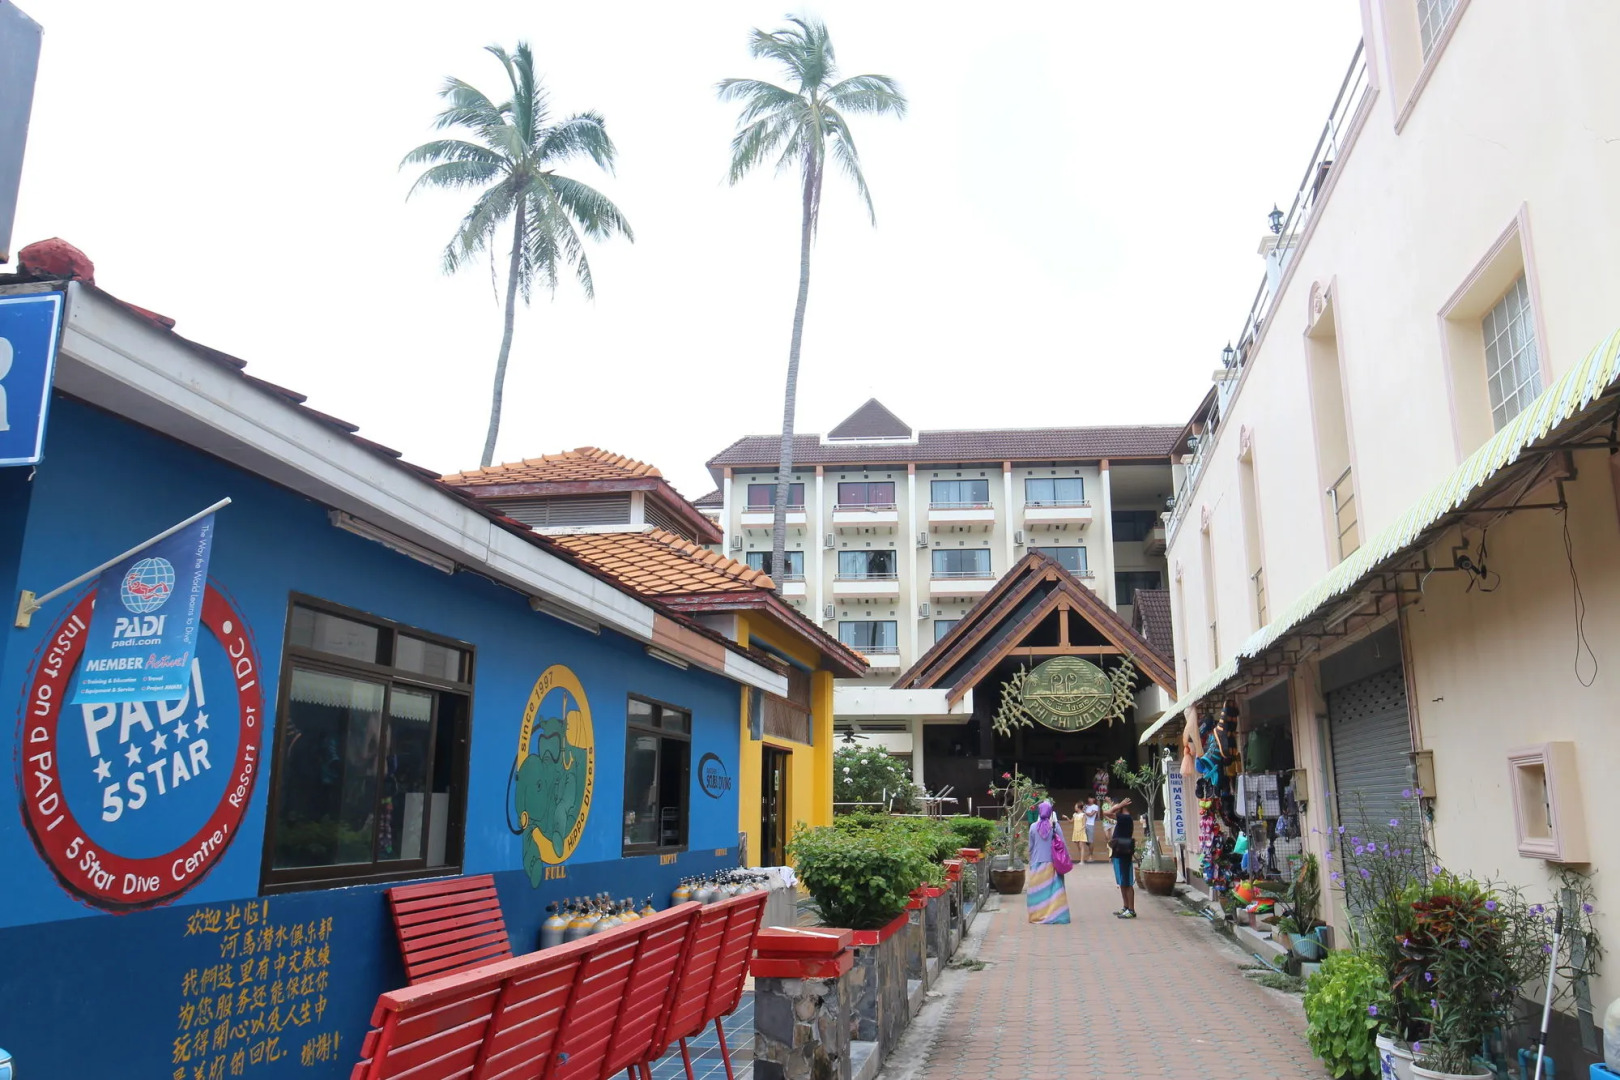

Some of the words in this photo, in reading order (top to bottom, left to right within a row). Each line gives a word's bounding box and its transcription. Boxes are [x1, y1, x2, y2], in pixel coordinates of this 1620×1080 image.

[200, 525, 209, 538] The
[197, 539, 207, 557] Way
[196, 557, 205, 569] the
[192, 571, 202, 593] World
[188, 594, 197, 616] Learns
[113, 615, 166, 638] PADI
[44, 614, 86, 679] Insist
[111, 637, 161, 648] padi.com
[86, 657, 143, 671] MEMBER
[230, 637, 255, 692] IDC
[535, 671, 554, 700] 1997
[34, 684, 52, 717] on
[247, 706, 256, 727] or
[1030, 700, 1049, 719] PHI
[1051, 715, 1070, 728] PHI
[1075, 700, 1110, 727] HOTEL
[229, 744, 255, 807] Resort
[29, 751, 64, 832] PADI
[567, 812, 585, 851] Hippo
[584, 746, 594, 807] Divers
[1173, 787, 1184, 835] MASSAGE
[66, 836, 84, 859] 5
[80, 850, 115, 890] Star
[659, 853, 678, 866] EMPTY
[123, 873, 160, 895] Dive
[544, 865, 567, 880] FULL
